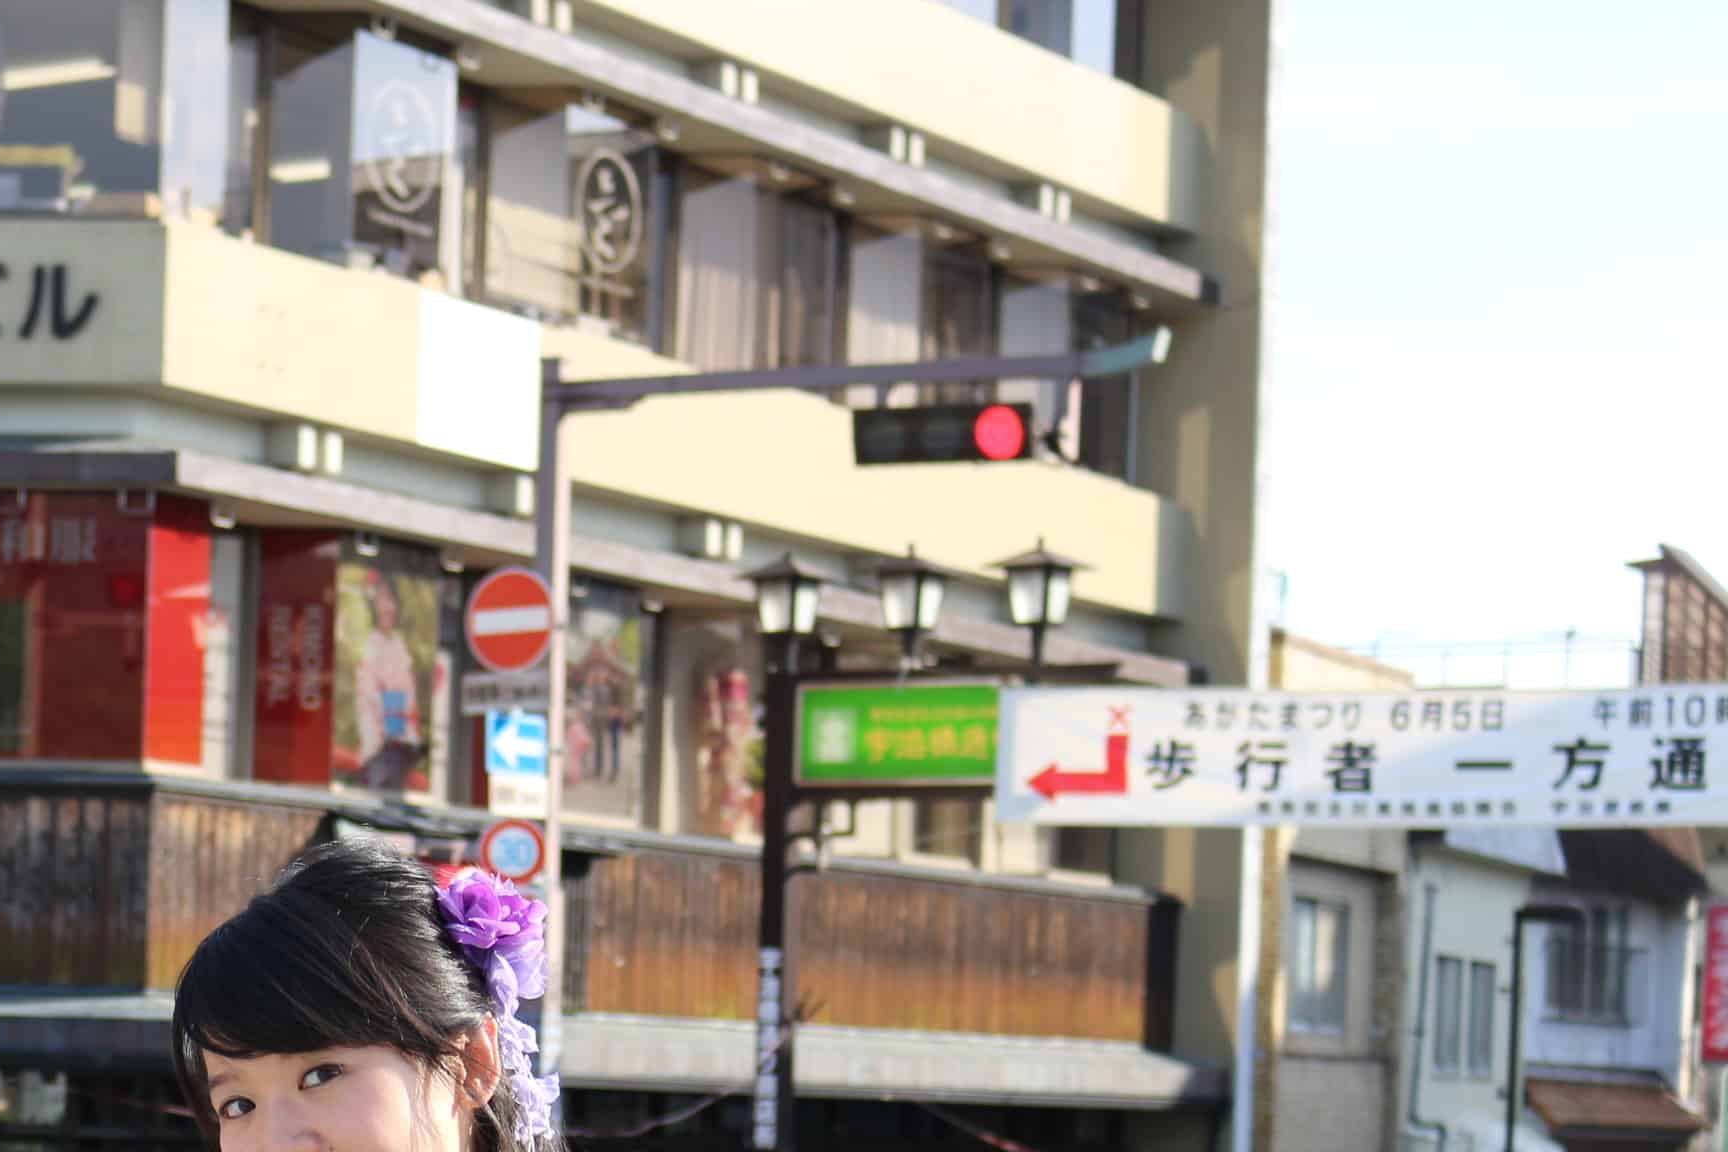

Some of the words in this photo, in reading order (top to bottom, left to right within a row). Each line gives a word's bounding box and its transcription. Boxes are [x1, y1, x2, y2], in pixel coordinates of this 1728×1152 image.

[1183, 698, 1361, 732] あがたまつり
[1389, 698, 1505, 733] 6月5日
[1144, 738, 1377, 794] 歩行者
